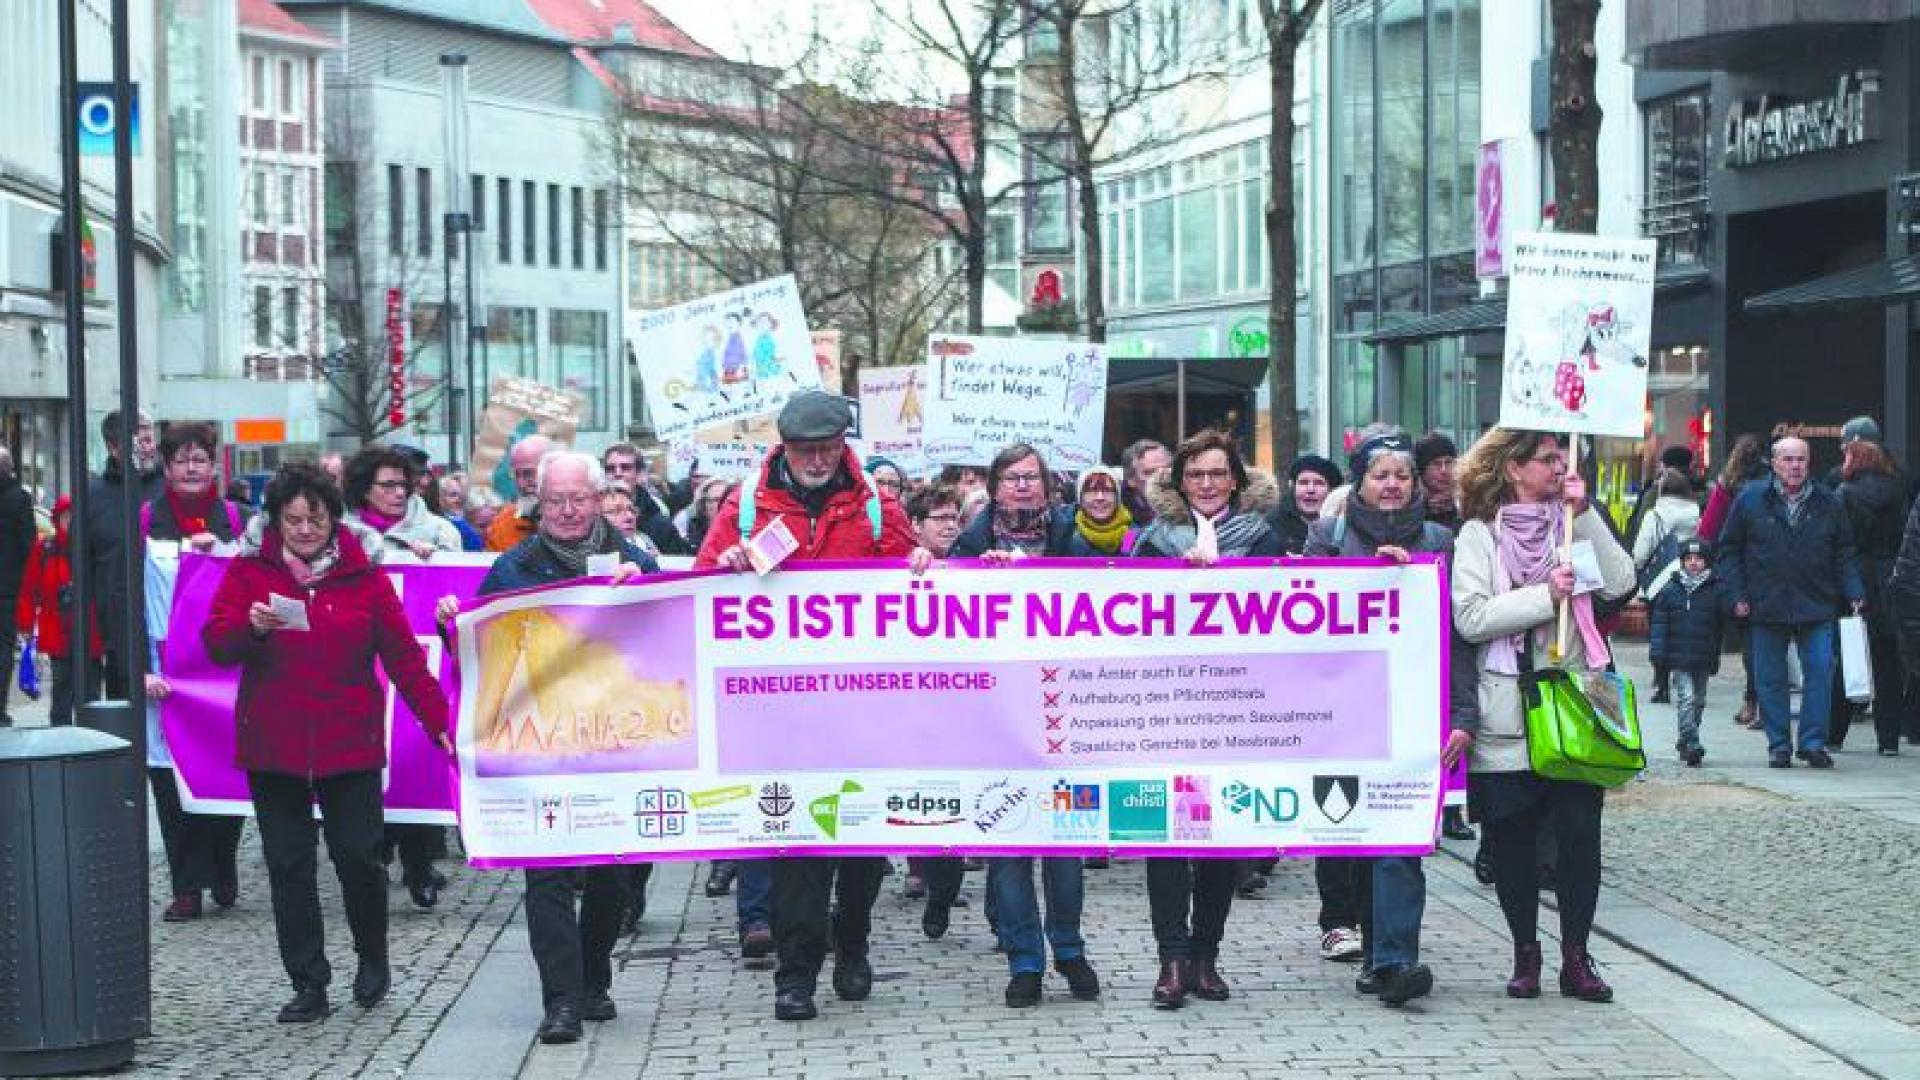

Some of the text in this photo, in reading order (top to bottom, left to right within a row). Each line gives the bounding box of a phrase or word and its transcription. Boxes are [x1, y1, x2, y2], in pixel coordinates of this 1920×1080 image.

[953, 359, 984, 374] Wer
[990, 360, 1032, 376] etwas
[952, 379, 996, 394] findet
[952, 412, 977, 426] Wer
[713, 580, 1400, 639] ES IST FÜNF NACH ZWÖLF!
[1068, 664, 1247, 681] Alle Ämter auch für Frauen
[726, 671, 997, 695] ERNEUERT UNSERE KIRCHE:
[1070, 691, 1141, 706] Aufhebung
[1145, 690, 1170, 703] des
[1070, 710, 1333, 731] Anpassung der kirchlichen Sexualmoral
[1070, 740, 1136, 753] Staatliche
[1140, 737, 1197, 751] Gerichte
[1202, 737, 1220, 749] bei
[1139, 783, 1165, 795] pax
[907, 792, 961, 816] dpsg
[1122, 792, 1165, 808] christi
[1254, 787, 1299, 823] ND
